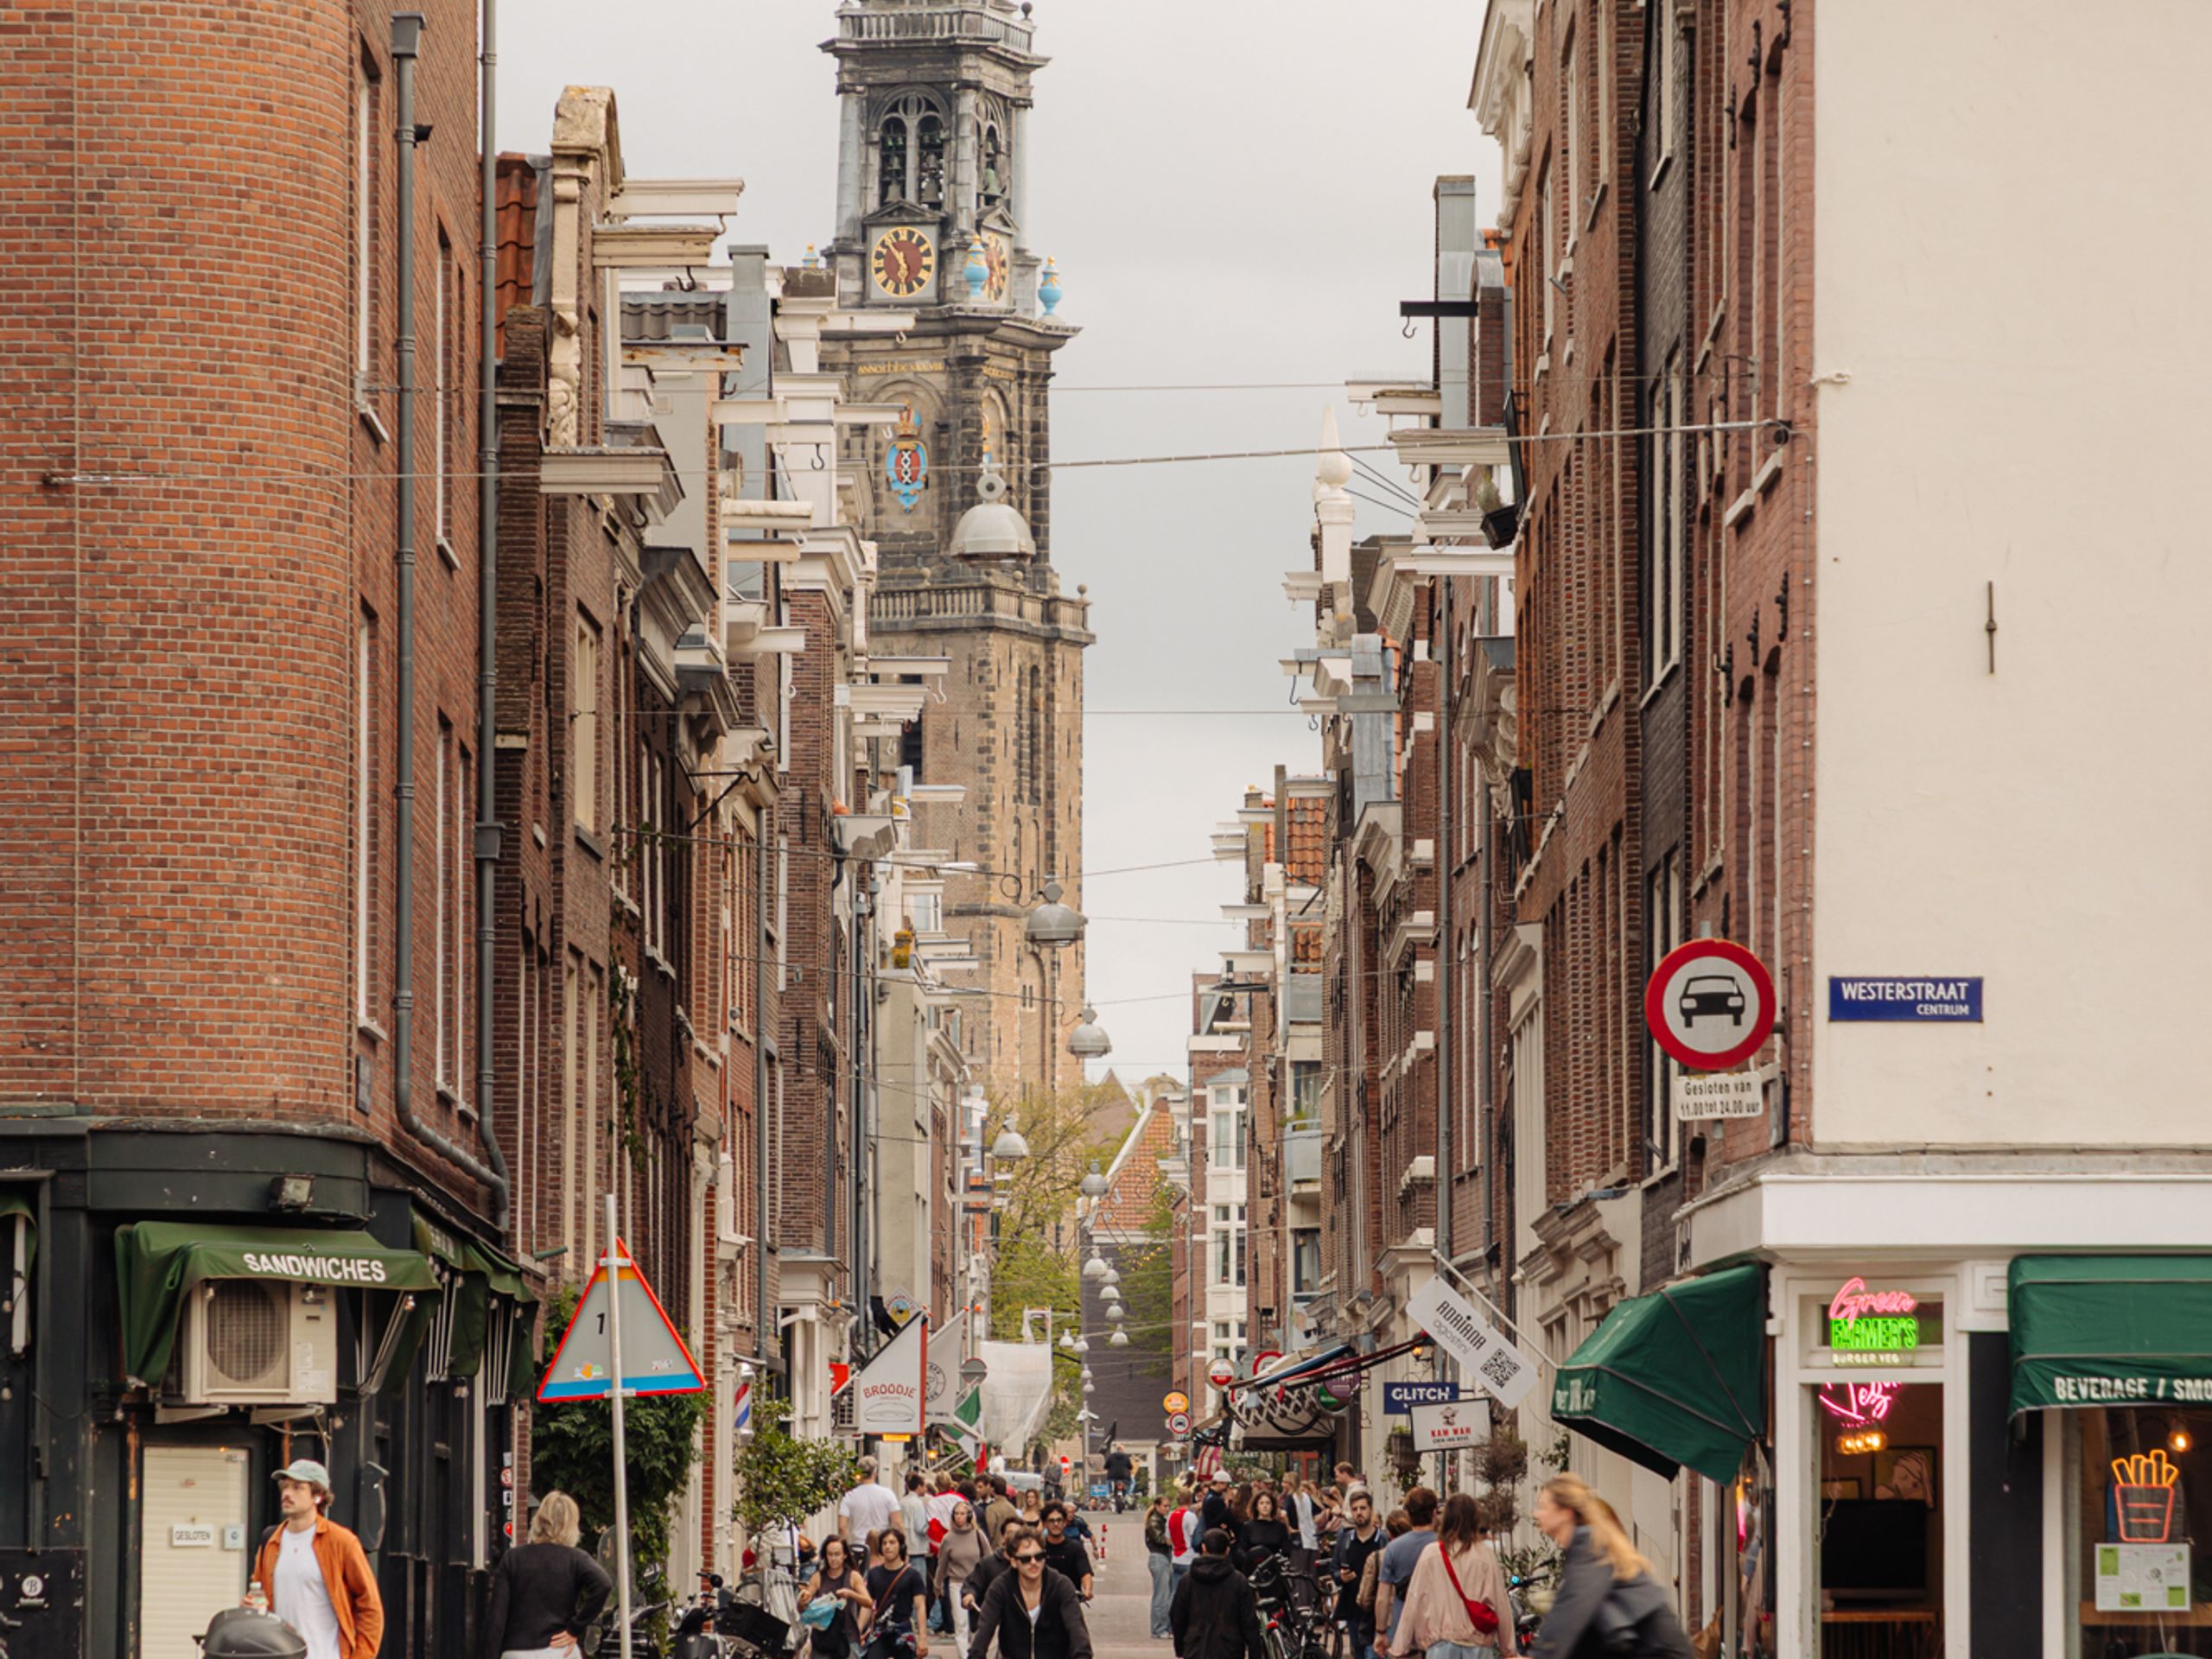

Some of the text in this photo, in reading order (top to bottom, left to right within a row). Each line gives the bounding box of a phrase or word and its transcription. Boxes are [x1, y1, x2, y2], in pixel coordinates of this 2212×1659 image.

[1840, 982, 1969, 1001] WESTERSTRAAT
[1916, 1003, 1970, 1015] CENTRUM
[1685, 1081, 1751, 1096] Gesloten van
[1681, 1102, 1704, 1116] 11.00
[1719, 1099, 1743, 1115] 24.00
[1746, 1102, 1759, 1113] uur
[243, 1253, 386, 1282] SANDWICHES
[1829, 1276, 1917, 1330] Green
[596, 1312, 606, 1335] 1
[1831, 1317, 1918, 1350] FARMER'S
[1433, 1319, 1471, 1355] agostini
[862, 1382, 917, 1400] BROODJE
[2054, 1376, 2149, 1402] BEVERAGE
